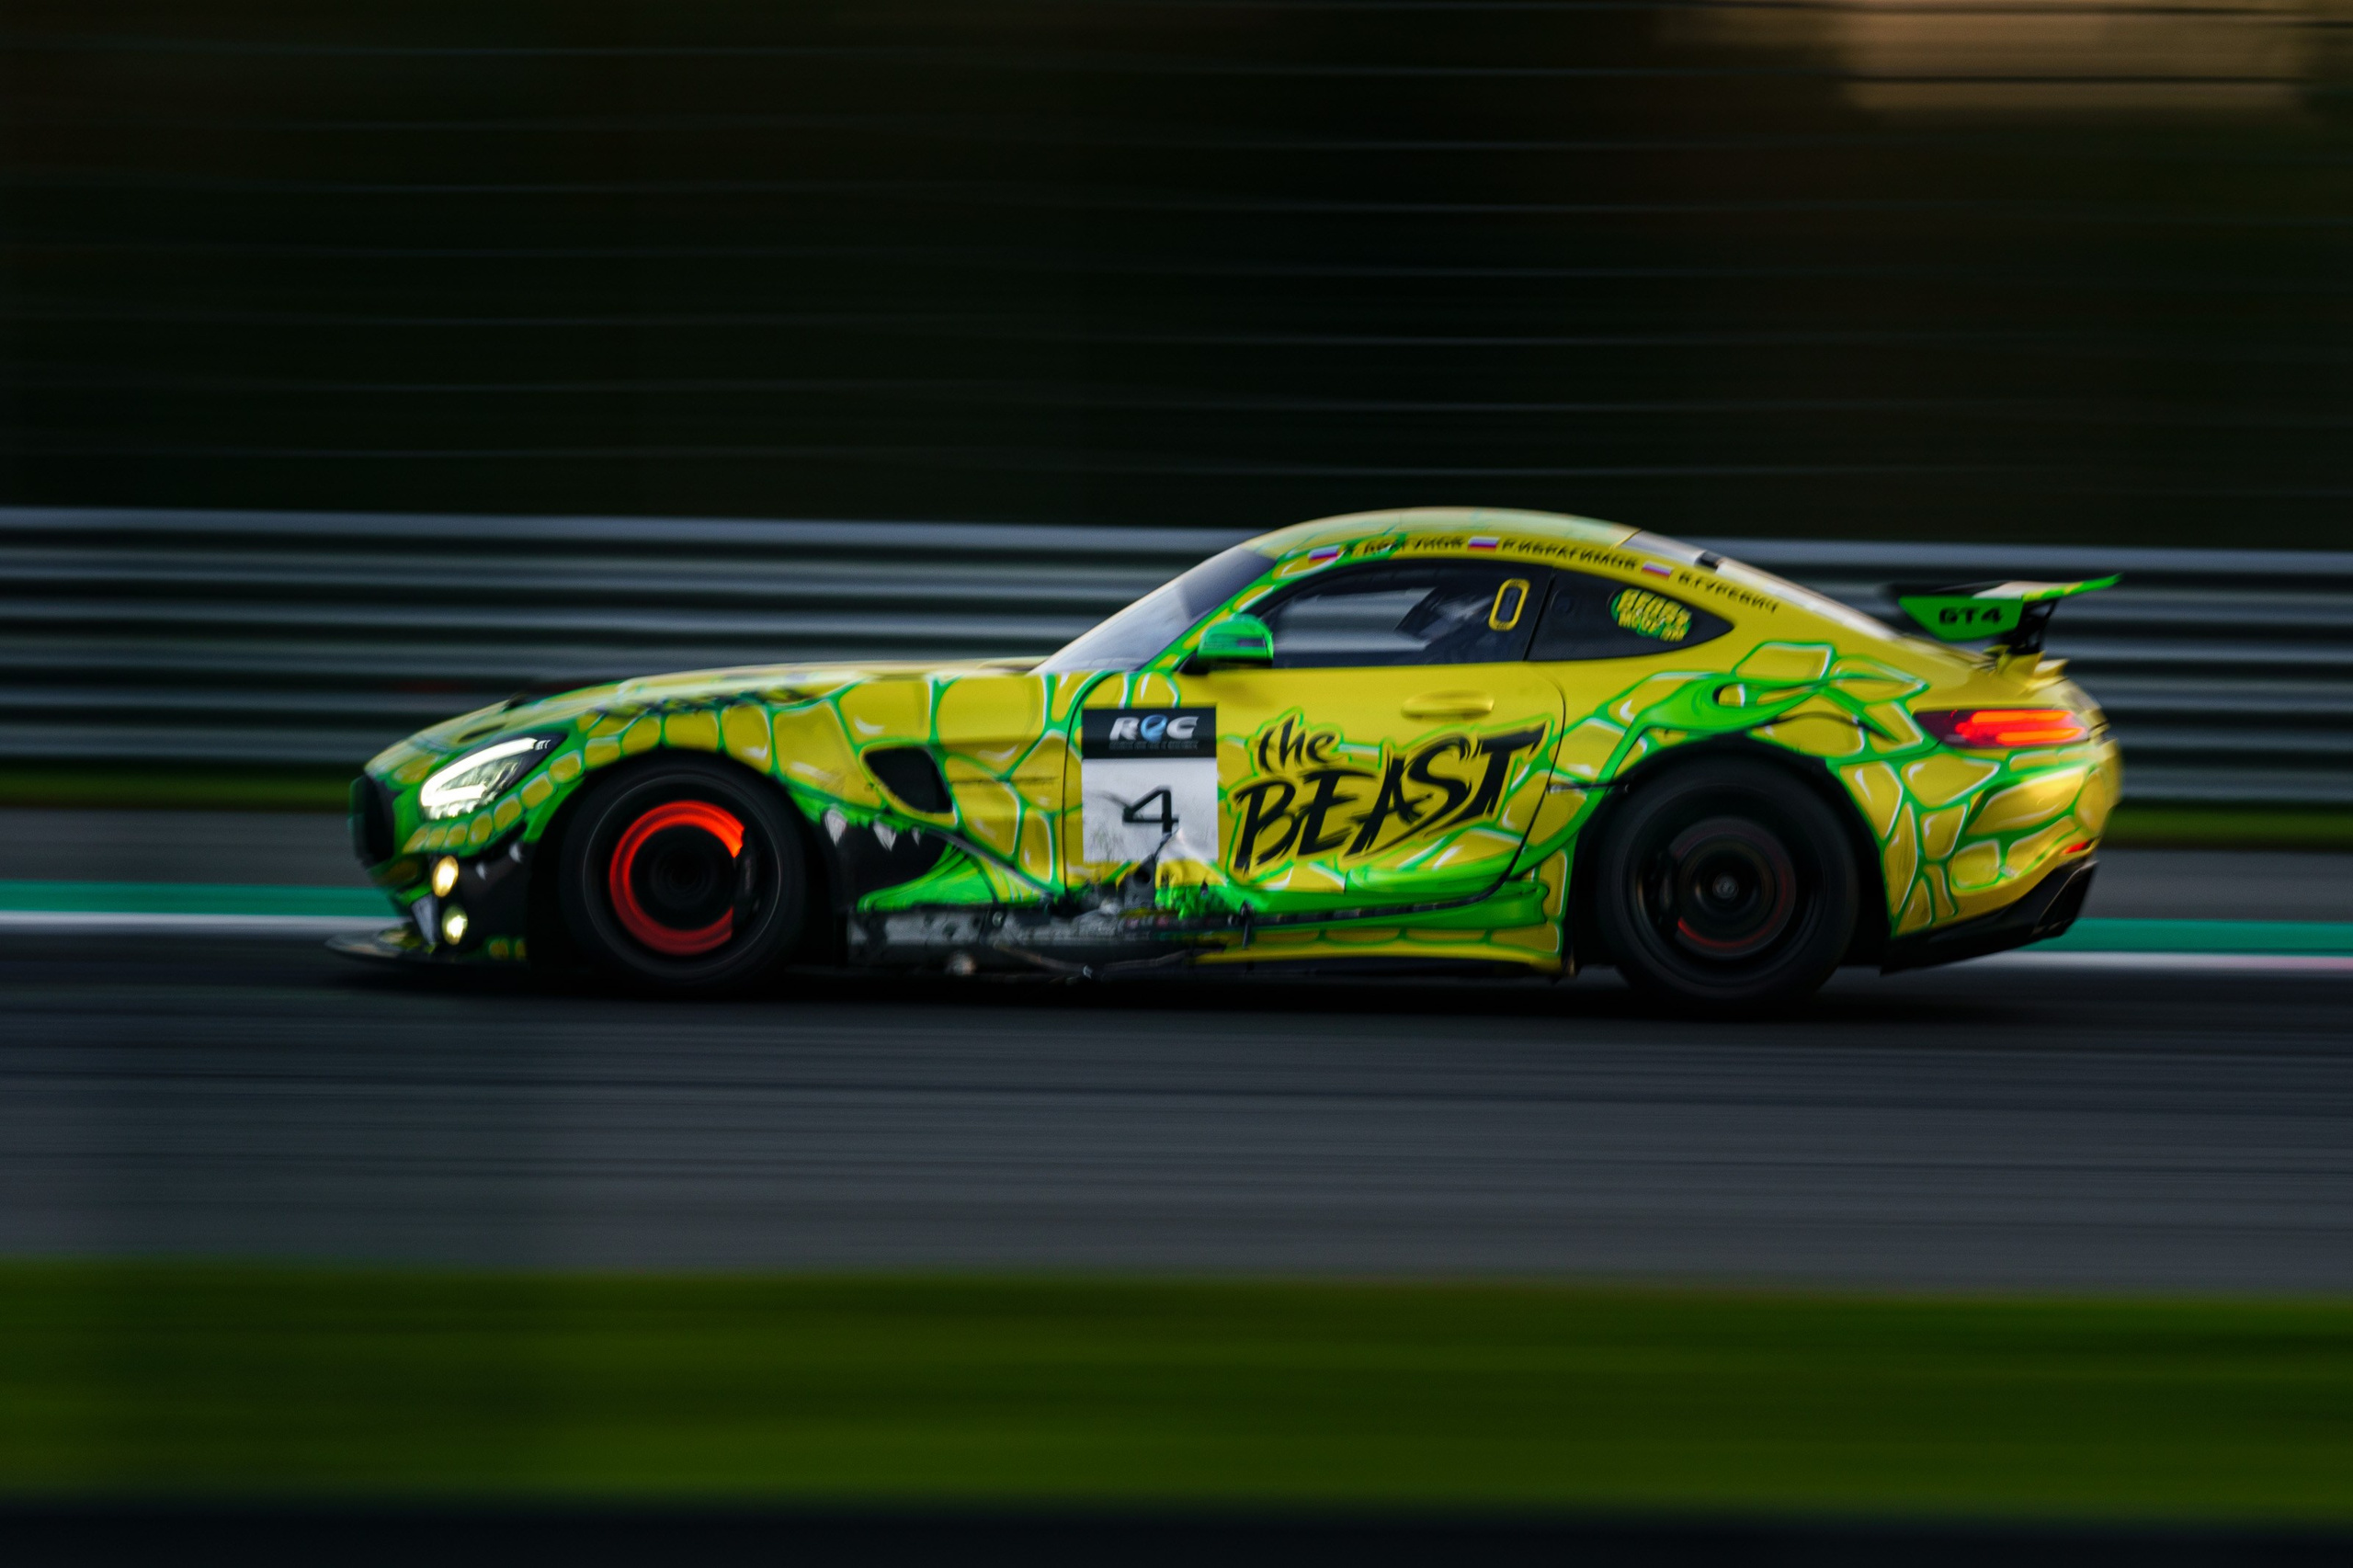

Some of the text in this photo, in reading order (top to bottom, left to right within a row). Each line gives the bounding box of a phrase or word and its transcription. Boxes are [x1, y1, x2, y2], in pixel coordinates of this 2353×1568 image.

[1677, 571, 1779, 613] В.ГУРЕВИЧ
[1938, 608, 2003, 623] GT4
[1259, 714, 1338, 771] the
[1121, 785, 1179, 833] 4
[1234, 721, 1549, 877] BEAST
